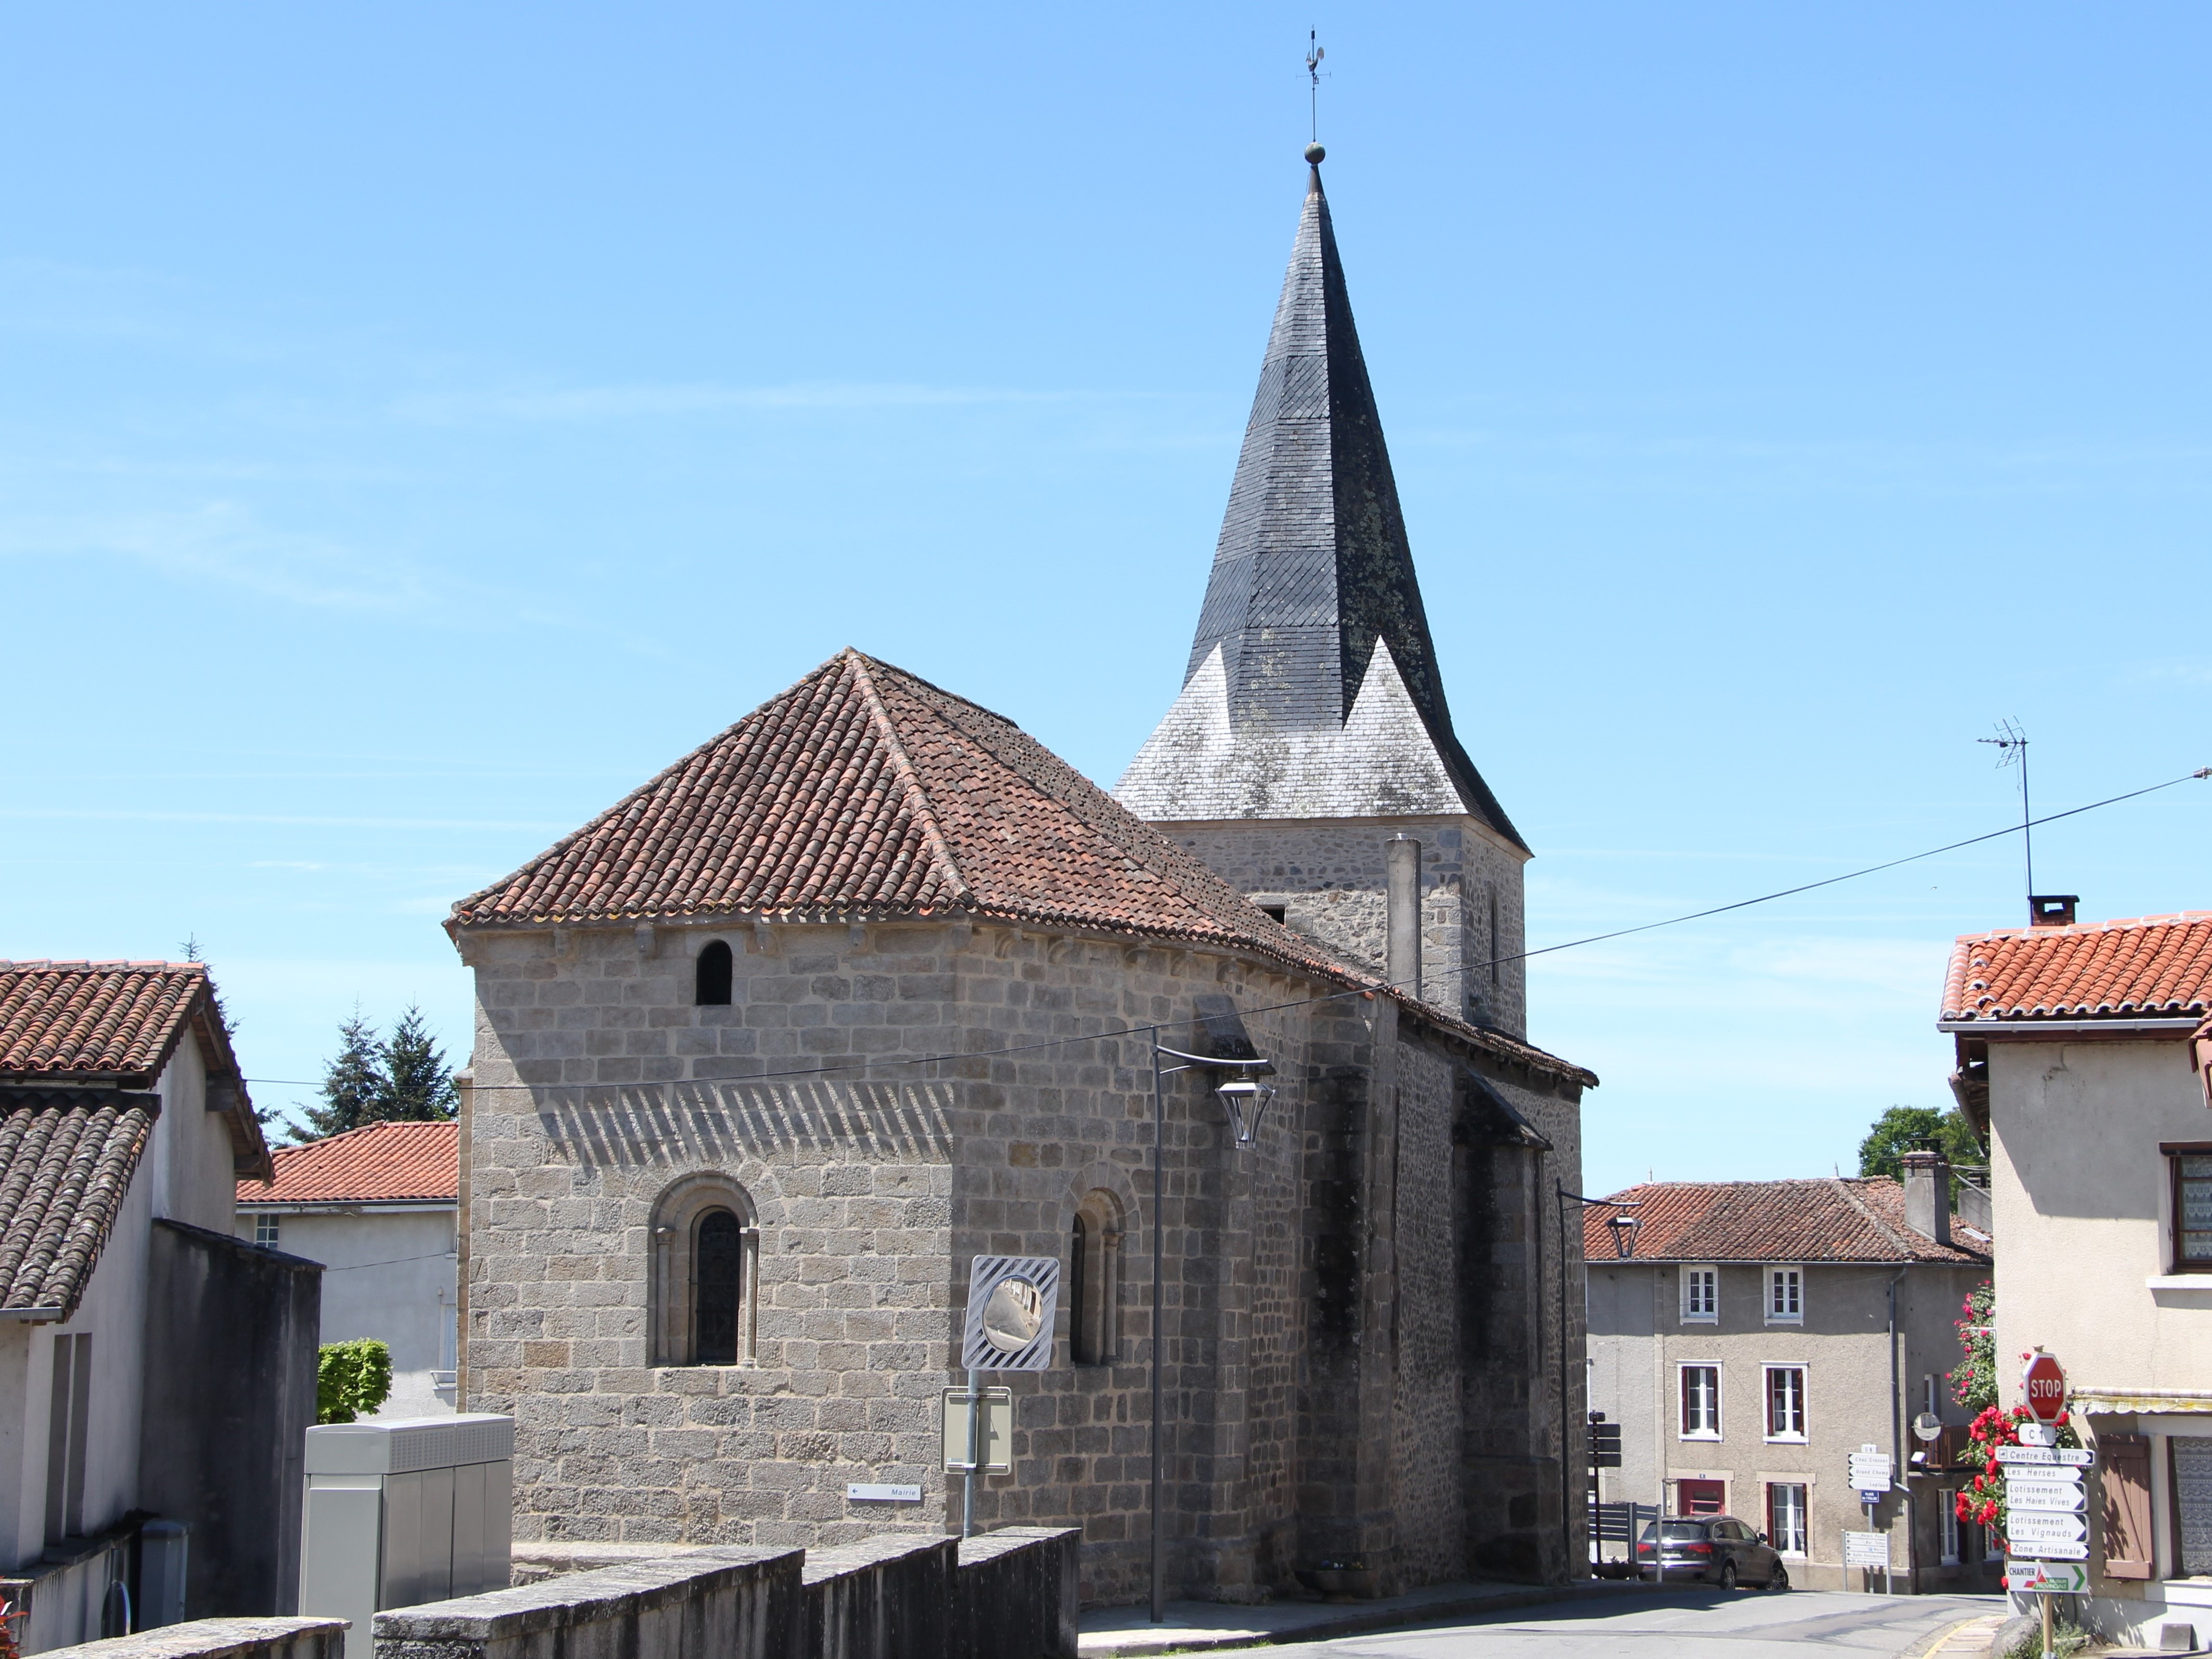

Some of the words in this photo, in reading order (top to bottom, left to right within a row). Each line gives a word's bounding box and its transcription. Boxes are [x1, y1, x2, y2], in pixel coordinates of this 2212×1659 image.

[2031, 1379, 2061, 1398] STOP
[2029, 1430, 2035, 1439] C
[2039, 1430, 2043, 1439] 1
[2010, 1451, 2038, 1459] Centre
[2042, 1452, 2079, 1463] Equestre
[2007, 1467, 2021, 1475] Les
[2027, 1468, 2056, 1477] Herses
[2010, 1485, 2062, 1494] Lotissement
[2026, 1496, 2046, 1505] Haies
[2050, 1497, 2070, 1506] Vives
[2010, 1516, 2064, 1525] Lotissement
[2032, 1528, 2072, 1538] Vignauds
[2013, 1544, 2033, 1552] Zone
[2038, 1546, 2081, 1556] Artisanale
[2009, 1567, 2035, 1576] CHANTIER
